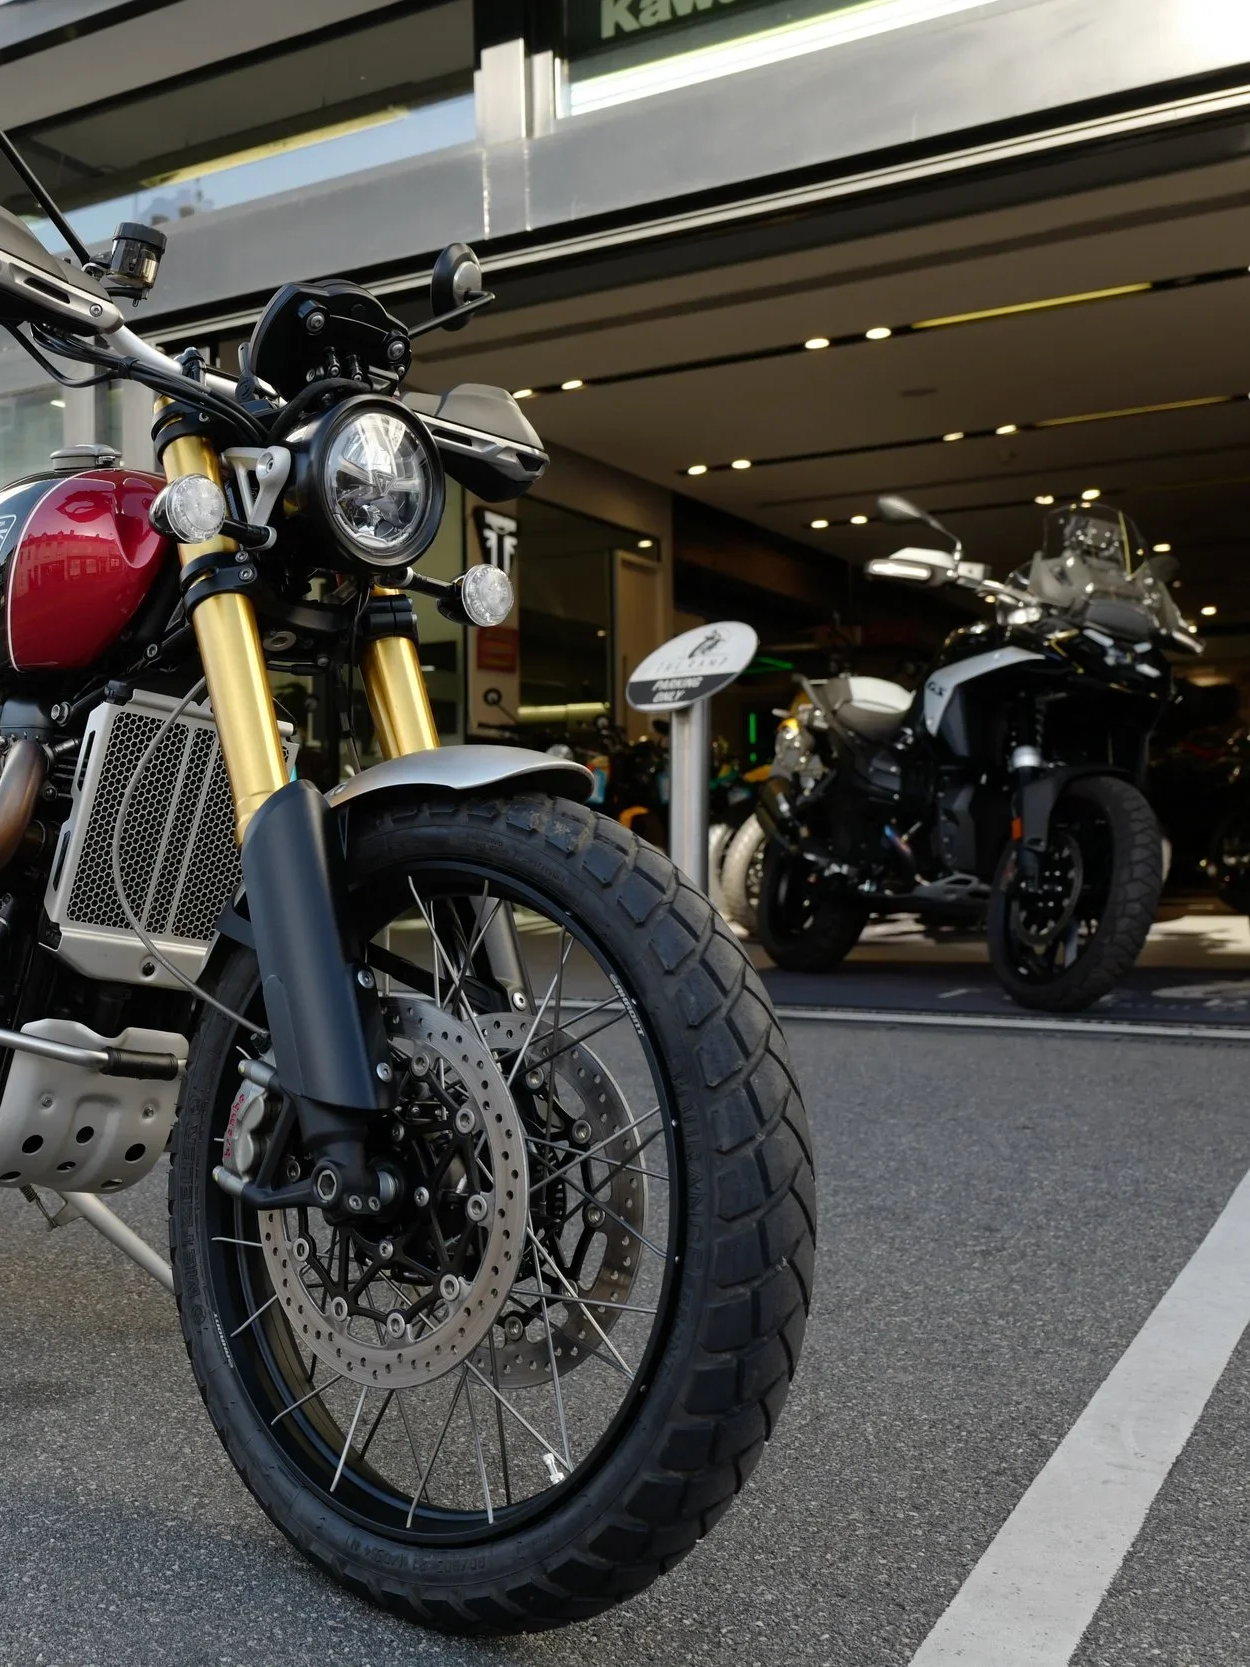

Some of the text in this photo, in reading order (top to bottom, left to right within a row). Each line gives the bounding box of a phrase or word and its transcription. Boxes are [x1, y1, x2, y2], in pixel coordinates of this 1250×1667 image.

[601, 0, 735, 39] Kaw
[652, 676, 704, 691] PARKING
[652, 690, 685, 703] ONLY
[224, 1094, 246, 1158] brembo
